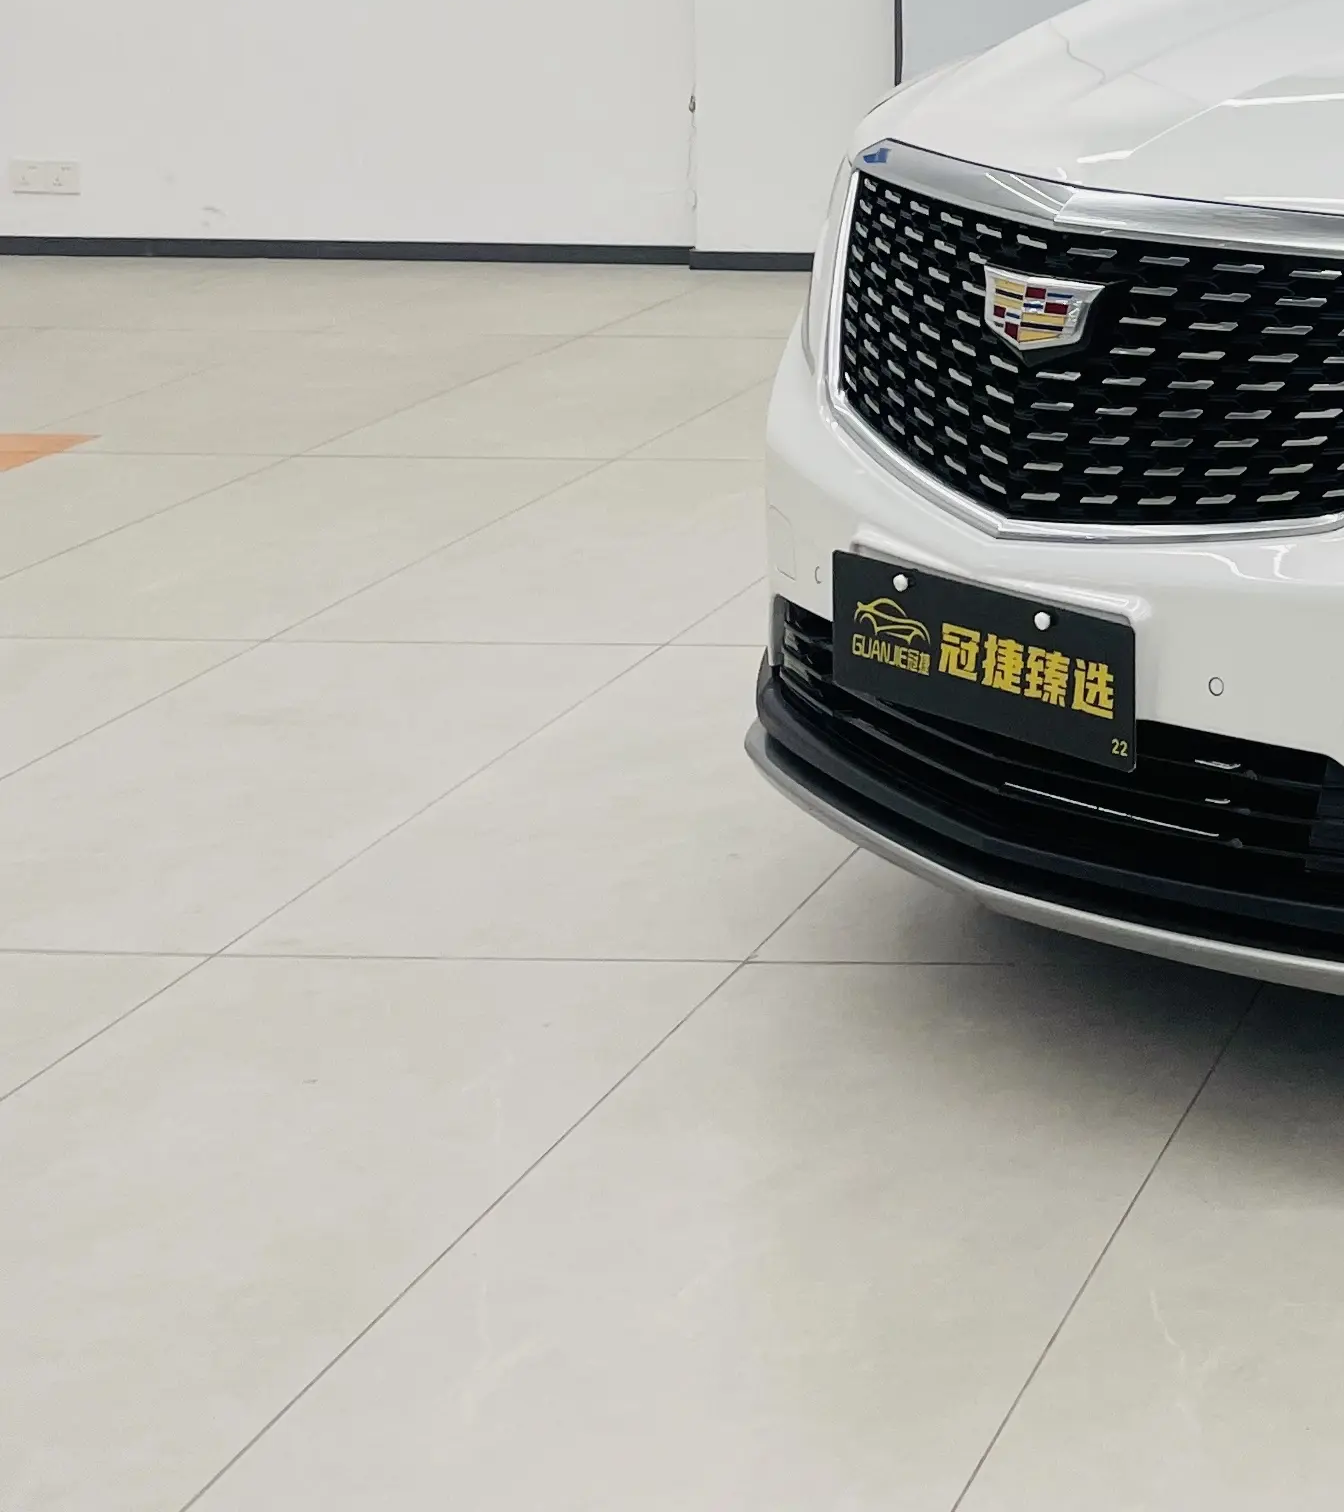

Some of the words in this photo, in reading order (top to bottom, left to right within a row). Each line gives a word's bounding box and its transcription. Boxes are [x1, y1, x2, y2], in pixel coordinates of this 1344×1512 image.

[938, 622, 1114, 719] 冠捷臻选
[1111, 738, 1129, 757] 22
